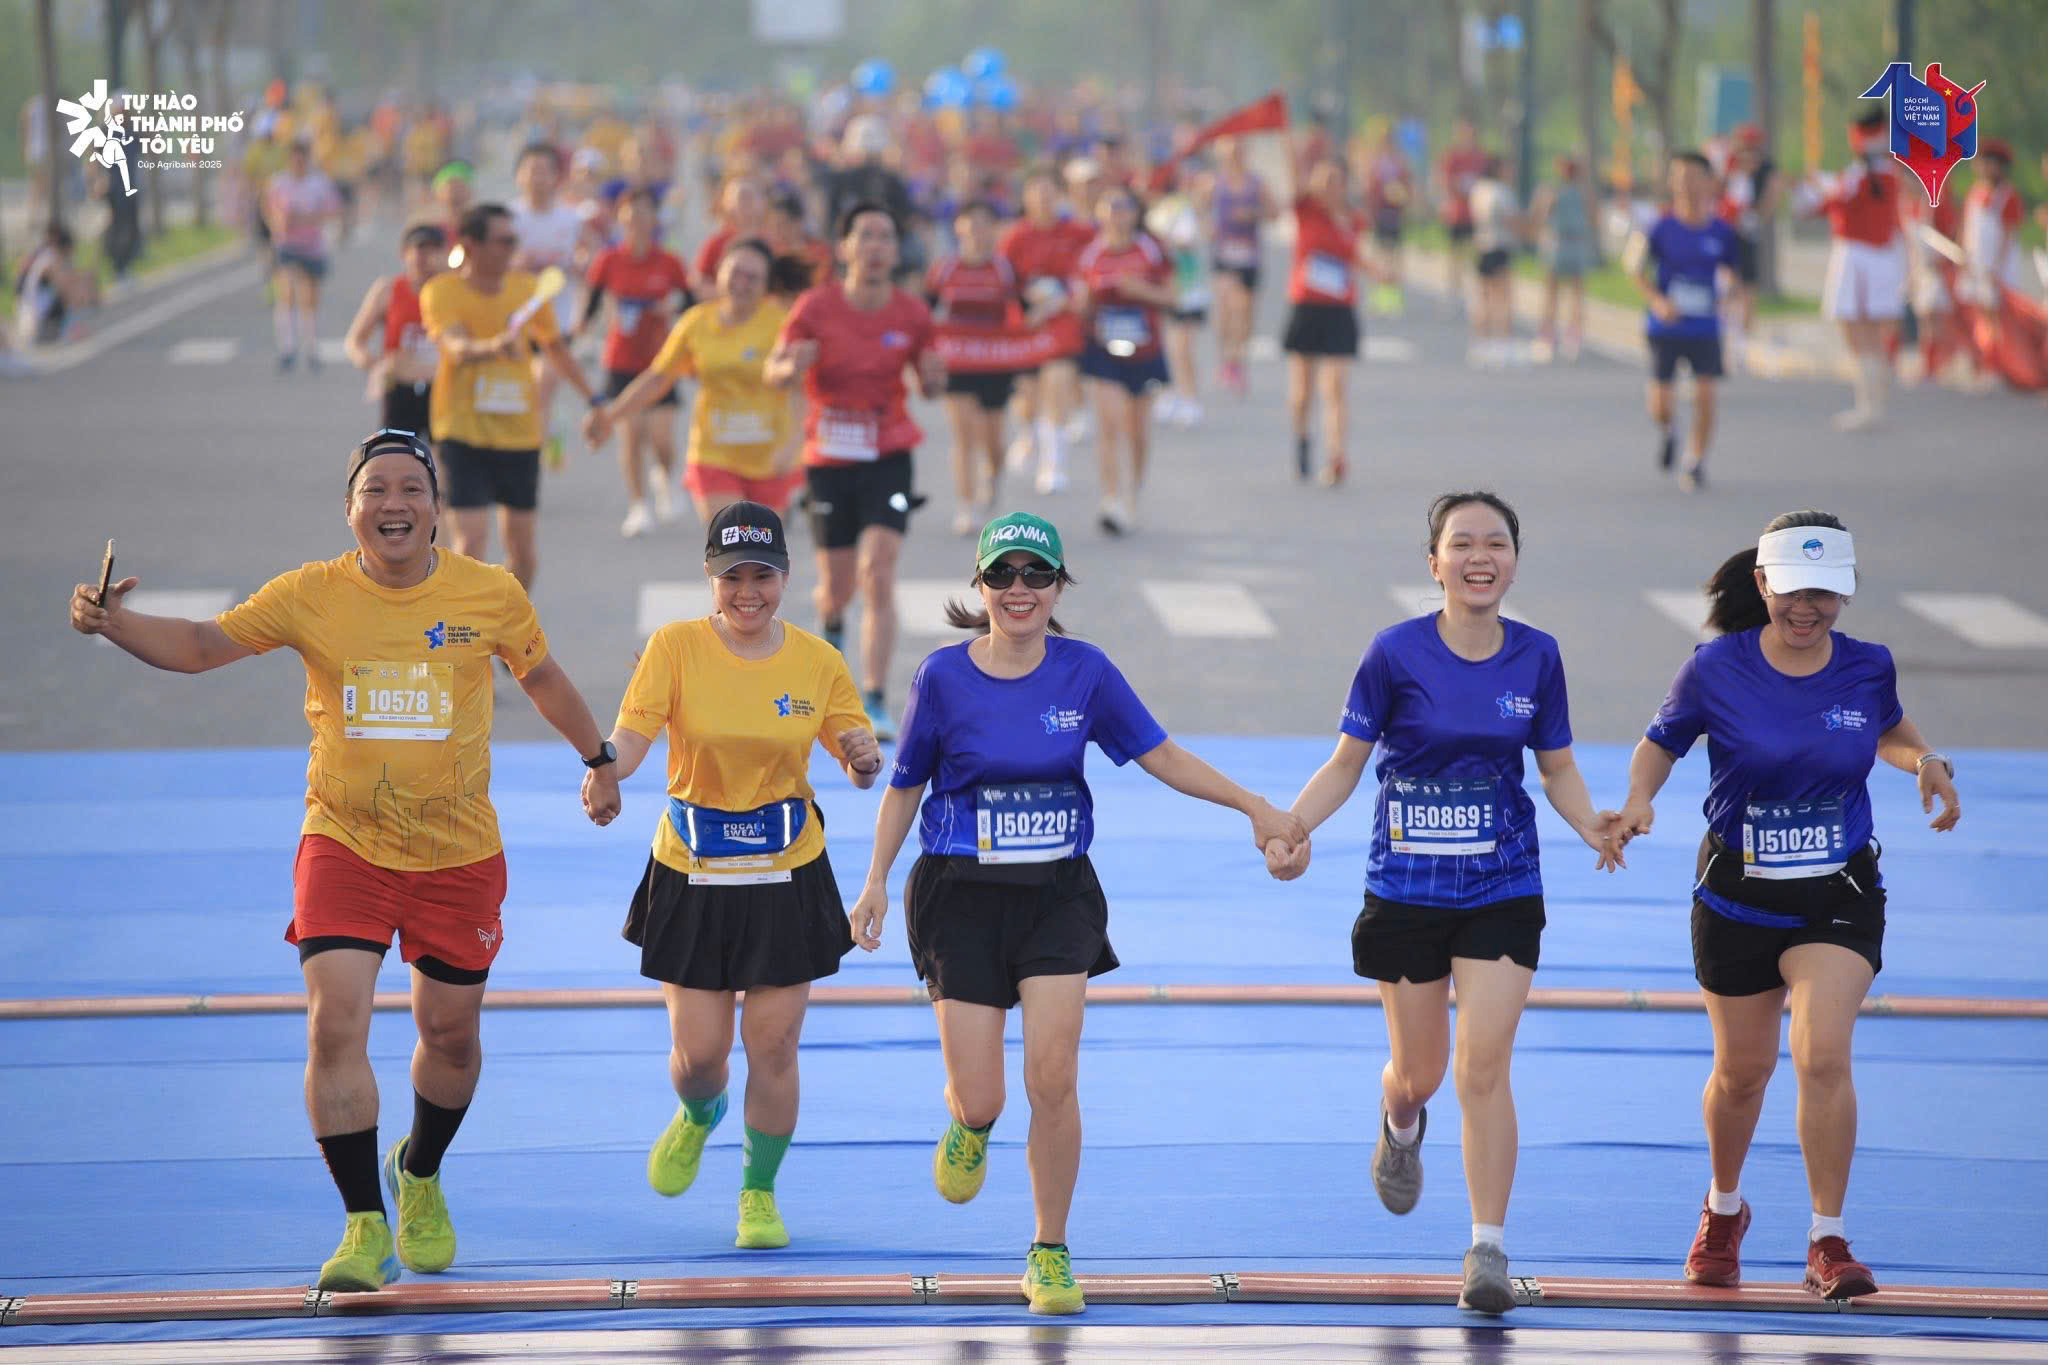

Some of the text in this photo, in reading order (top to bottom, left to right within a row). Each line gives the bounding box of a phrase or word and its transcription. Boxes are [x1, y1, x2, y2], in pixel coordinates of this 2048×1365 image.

[989, 524, 1050, 547] HONMA
[346, 689, 354, 711] 10KM
[368, 689, 429, 713] 10578
[994, 809, 1068, 838] J50220
[1405, 804, 1480, 829] J50869
[1757, 825, 1828, 852] J51028
